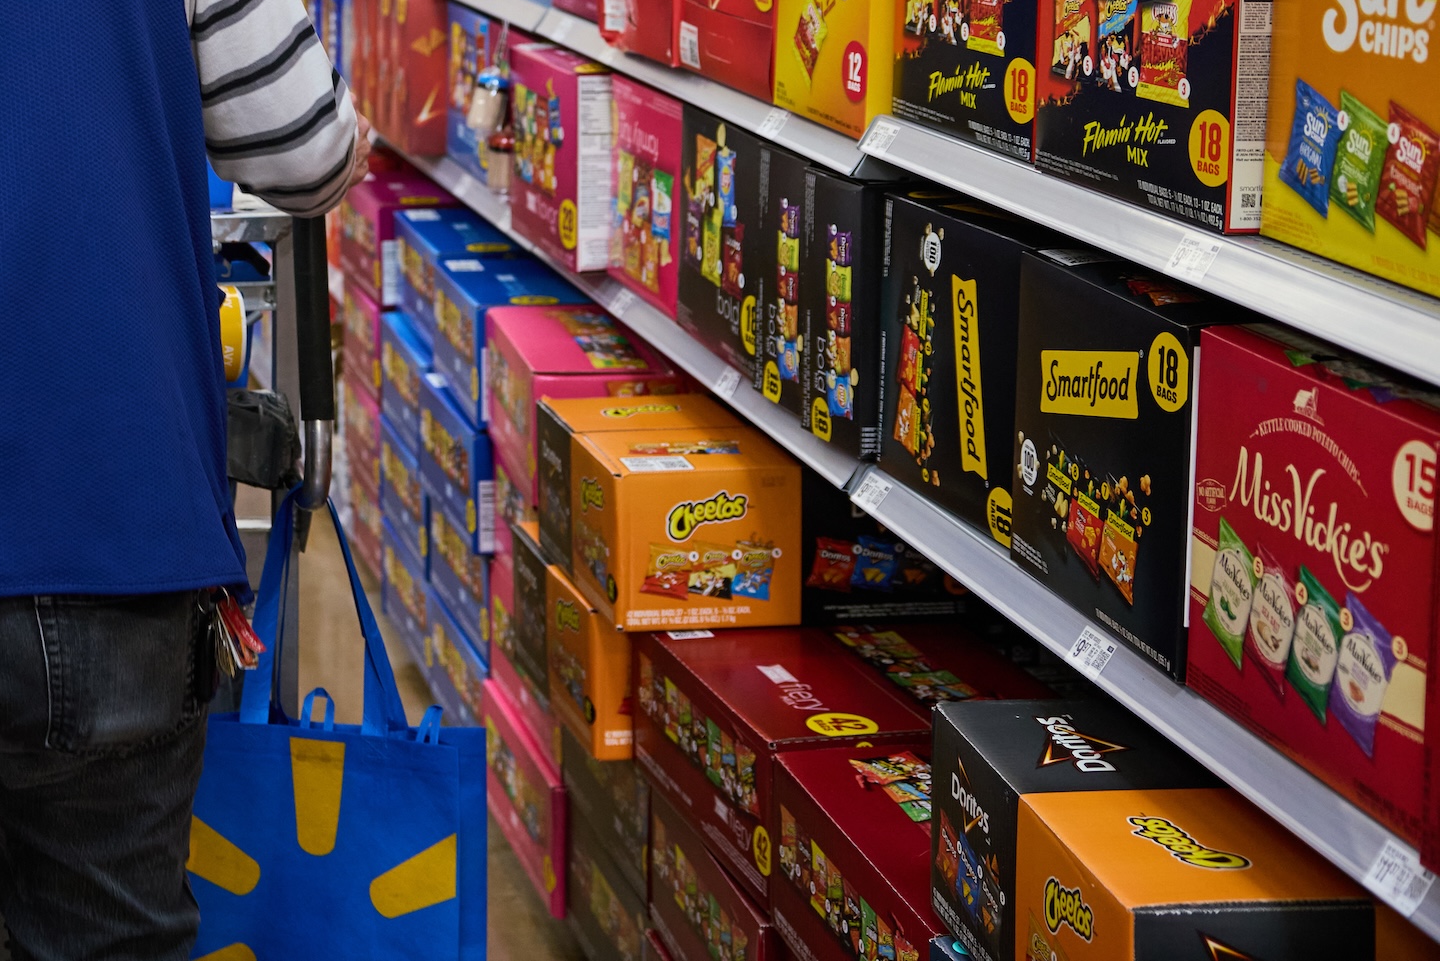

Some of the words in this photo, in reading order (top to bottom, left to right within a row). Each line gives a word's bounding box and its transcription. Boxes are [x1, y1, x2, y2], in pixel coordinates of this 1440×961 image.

[1359, 20, 1430, 64] CHIPS
[848, 51, 862, 82] 12
[847, 80, 861, 93] BAGS
[929, 65, 965, 102] Flamin'
[966, 61, 990, 88] Hot
[1011, 68, 1028, 102] 18
[961, 90, 977, 109] MIX
[1010, 101, 1027, 114] BAGS
[1082, 114, 1133, 157] Flamin'
[1134, 111, 1169, 145] Hot
[1304, 111, 1326, 139] Sun
[1199, 120, 1222, 162] 18
[1346, 128, 1371, 156] Sun
[1396, 136, 1423, 165] Sun
[1126, 145, 1149, 168] MIX
[1197, 161, 1220, 176] BAGS
[768, 302, 778, 358] bold
[817, 337, 827, 394] bold
[957, 289, 982, 462] Smartfood
[1159, 345, 1178, 389] 18
[768, 371, 778, 395] 18
[1046, 359, 1131, 407] Smartfood
[1156, 385, 1177, 404] BAGS
[818, 408, 828, 434] 18
[1258, 417, 1283, 437] KETTLE
[1284, 417, 1311, 438] COOKED
[1311, 429, 1338, 455] POTATO
[1337, 447, 1361, 482] CHIPS
[1048, 467, 1070, 490] Smartfood
[1405, 453, 1436, 500] 15
[1078, 494, 1099, 514] Smartfood
[1198, 487, 1207, 497] NO
[1207, 487, 1224, 499] ARTIFICIAL
[1407, 497, 1433, 516] BAGS
[667, 490, 748, 542] Cheetos
[995, 507, 1012, 539] 18
[1108, 514, 1135, 538] Smartfood
[1229, 445, 1292, 532] Miss
[1285, 463, 1384, 593] Vickie's
[657, 553, 687, 568] Cheetos
[820, 549, 851, 563] Doritos
[862, 548, 894, 561] Doritos
[1255, 560, 1261, 573] 5
[1261, 604, 1269, 617] SEA
[780, 680, 830, 712] fiery
[829, 716, 870, 733] 42
[1036, 715, 1118, 773] Doritos
[951, 771, 990, 834] Doritos
[1129, 816, 1253, 869] Cheetos
[1044, 876, 1094, 943] Cheetos
